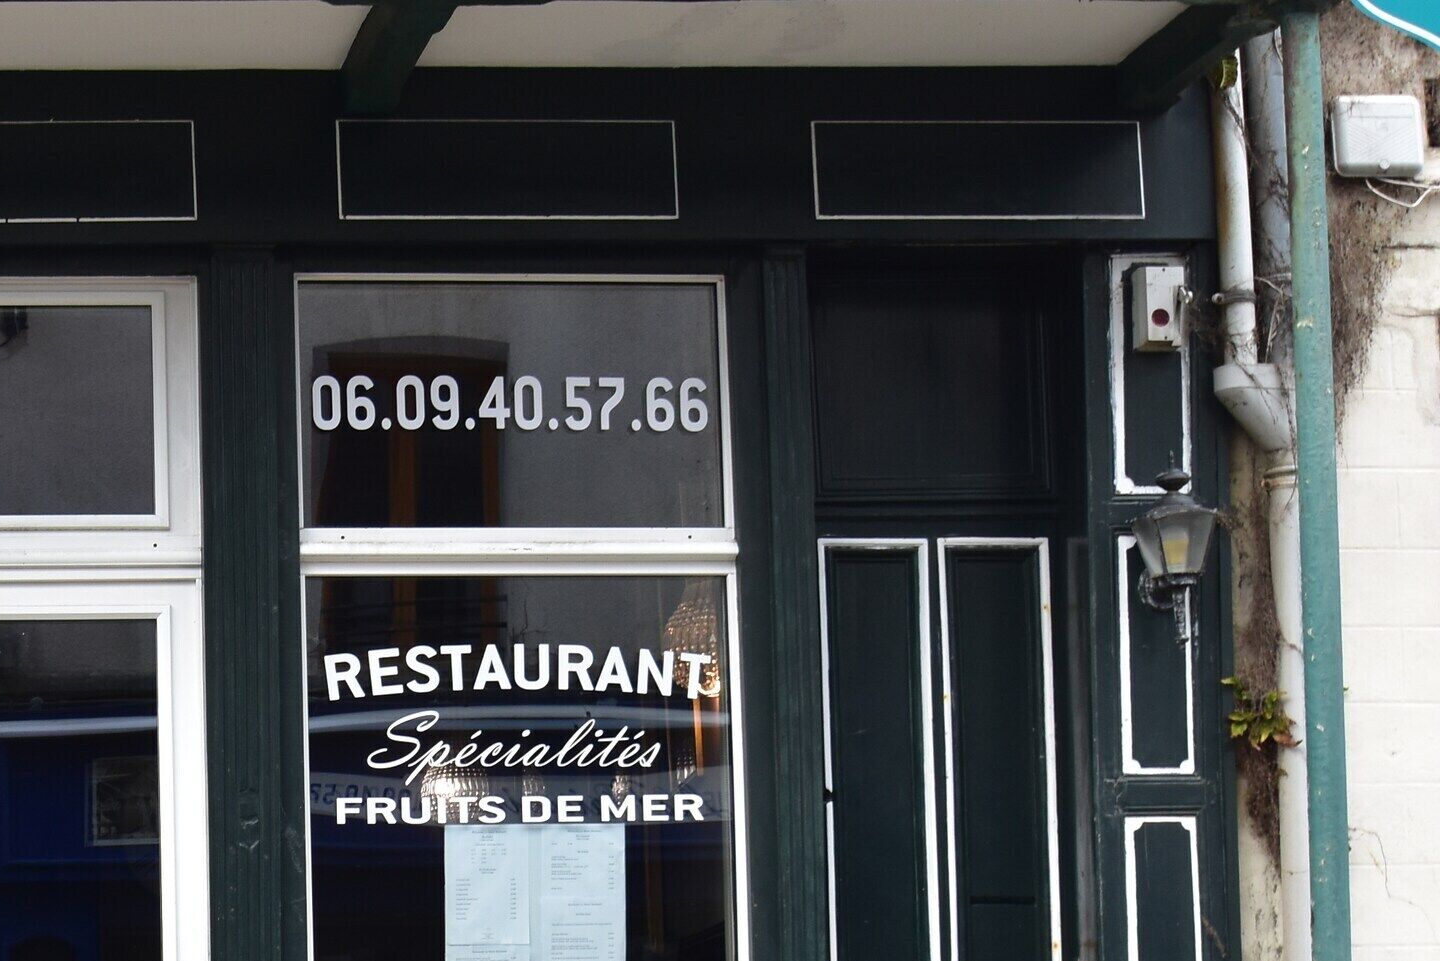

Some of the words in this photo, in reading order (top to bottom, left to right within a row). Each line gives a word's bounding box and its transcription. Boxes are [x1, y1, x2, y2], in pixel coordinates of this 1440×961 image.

[312, 375, 709, 433] 06.09.40.57.66
[323, 643, 712, 701] RESTAURANT
[366, 710, 661, 786] Spécialités
[335, 795, 507, 825] FRUITS
[521, 794, 585, 823] DE
[600, 793, 705, 822] MER
